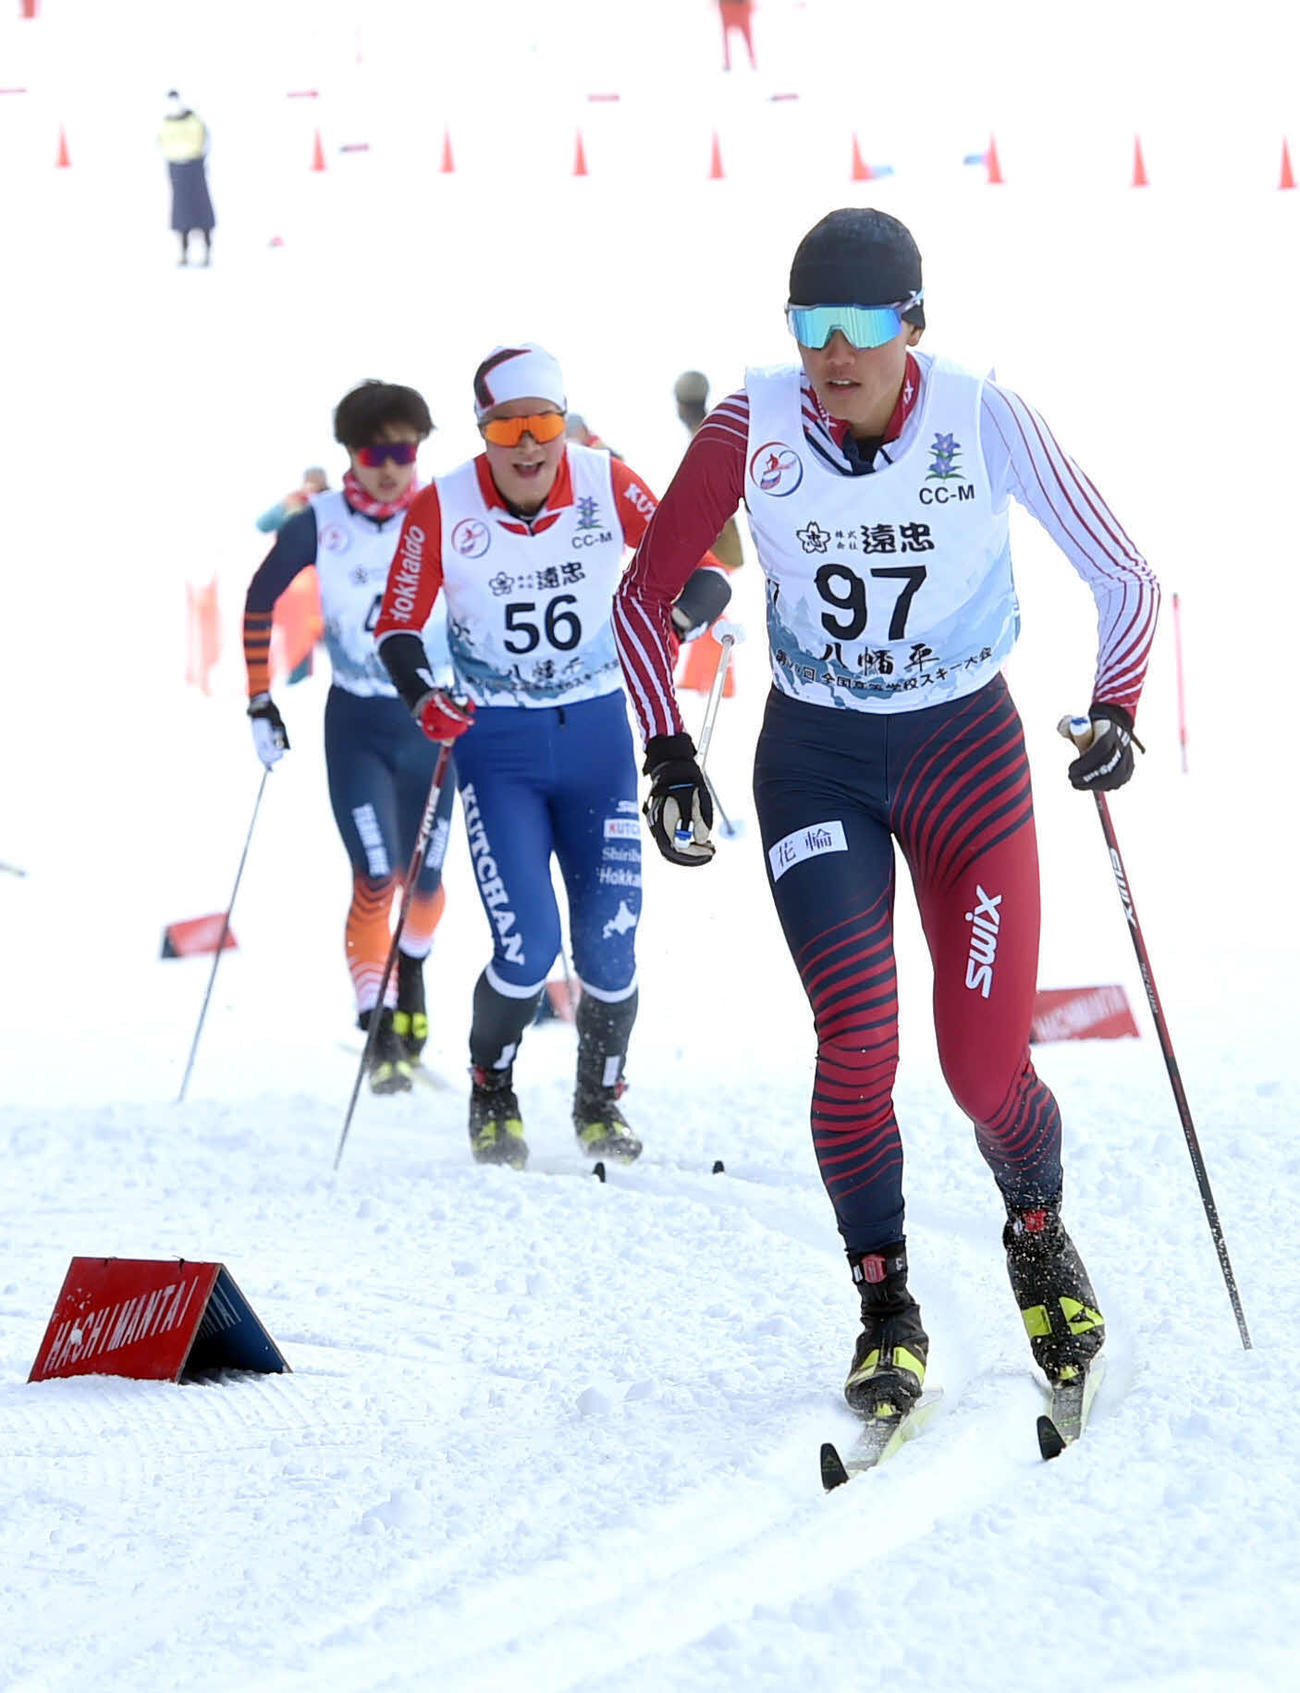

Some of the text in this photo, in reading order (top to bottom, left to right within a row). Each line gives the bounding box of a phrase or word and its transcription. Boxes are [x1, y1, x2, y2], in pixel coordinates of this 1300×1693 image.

[919, 485, 975, 505] CC-M
[571, 532, 612, 549] CC-M
[860, 522, 935, 554] 遠忠
[815, 563, 928, 641] 97
[504, 594, 582, 654] 56
